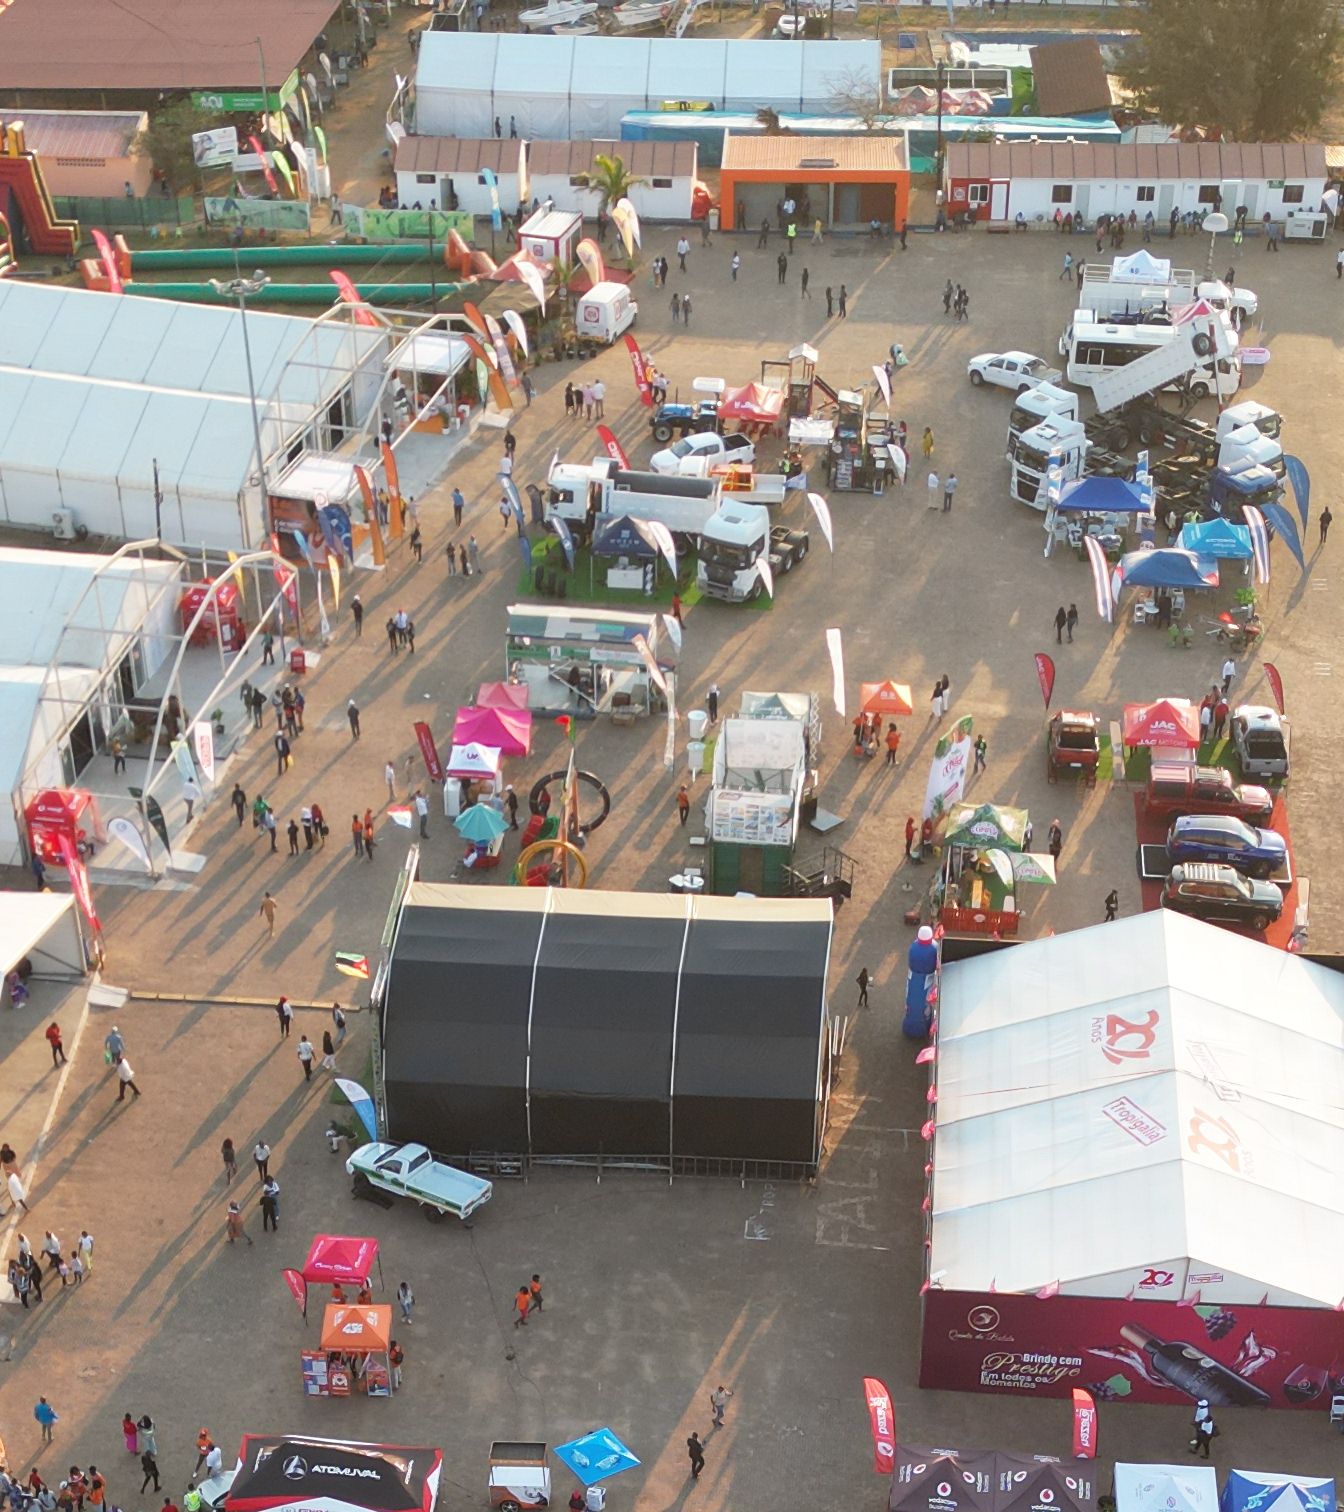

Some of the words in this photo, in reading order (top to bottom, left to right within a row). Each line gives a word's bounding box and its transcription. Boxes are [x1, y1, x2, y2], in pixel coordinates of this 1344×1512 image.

[1150, 721, 1177, 730] JAC
[1136, 738, 1156, 746] JAC
[1157, 739, 1188, 747] MOTORS
[1091, 1017, 1105, 1044] Anos
[1110, 1101, 1161, 1140] Tropigalia
[1023, 1353, 1056, 1364] Brinde
[1059, 1357, 1082, 1365] com
[981, 1352, 1081, 1383] Prestige
[981, 1371, 999, 1381] Em
[1001, 1373, 1032, 1382] todos
[981, 1379, 1036, 1389] Momentos
[311, 1464, 381, 1480] ATOMUVAL
